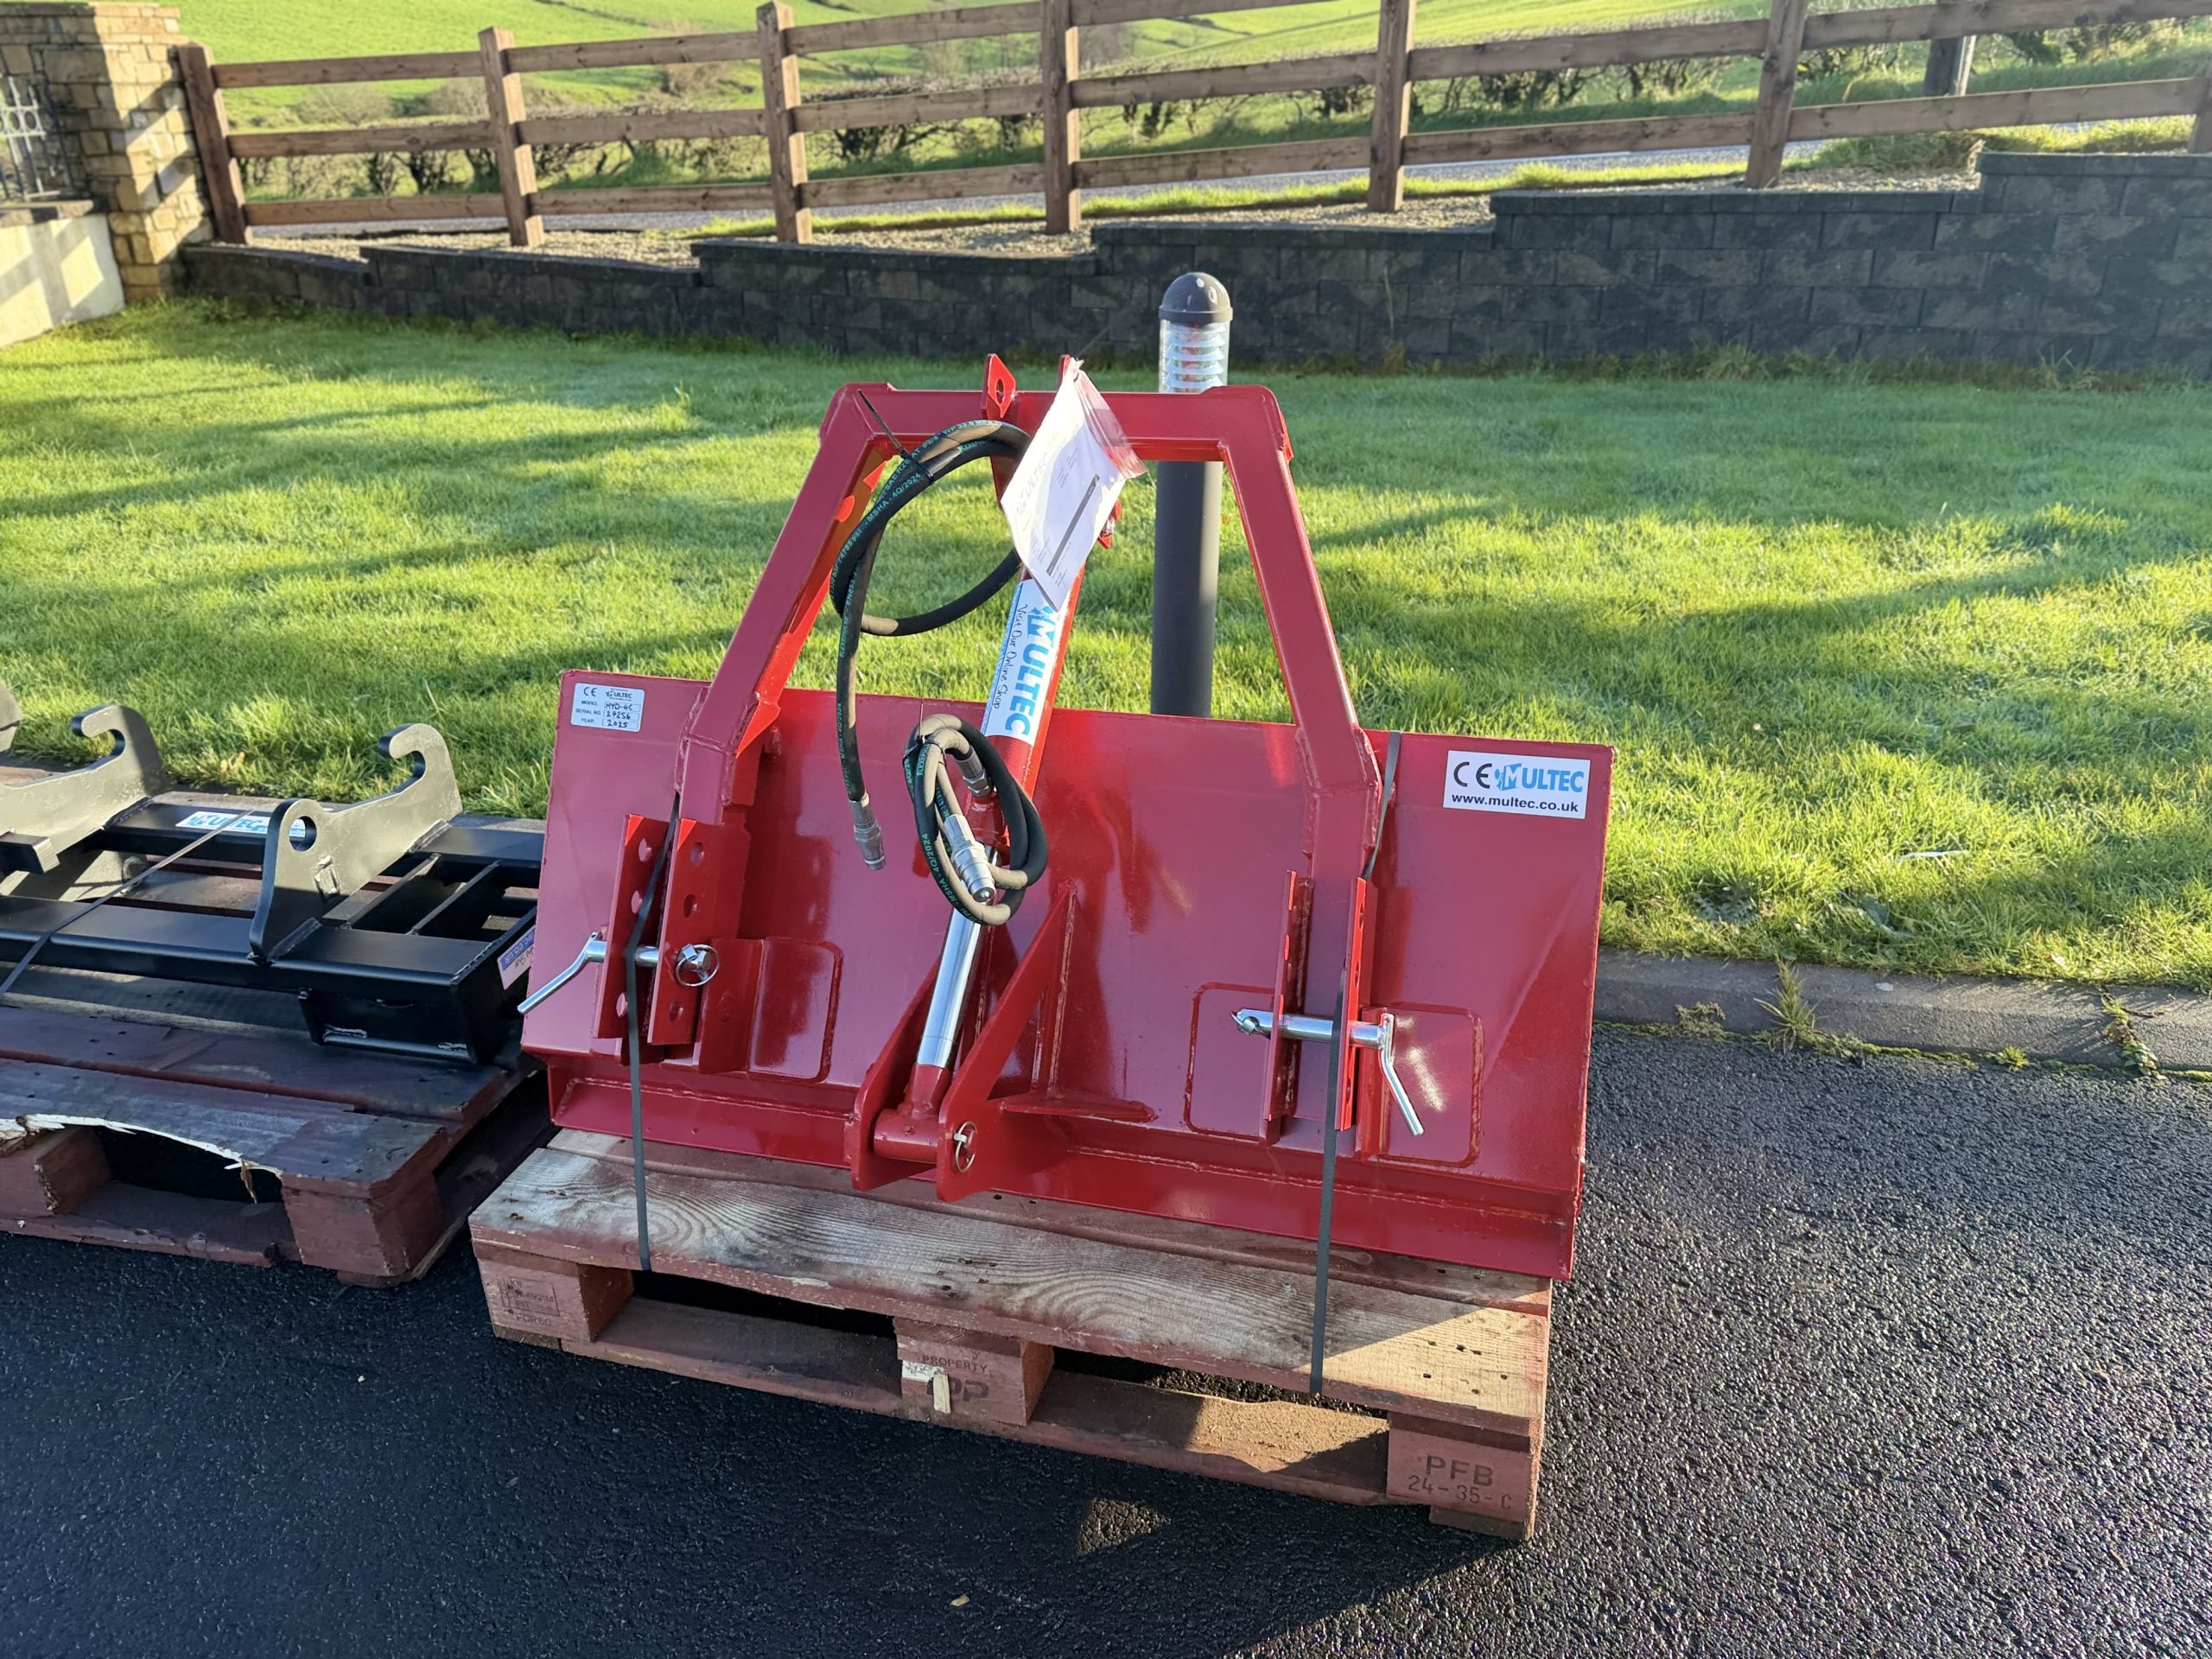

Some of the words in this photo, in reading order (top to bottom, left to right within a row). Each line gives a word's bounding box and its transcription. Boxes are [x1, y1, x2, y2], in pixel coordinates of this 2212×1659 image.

[866, 500, 889, 523] MSHA
[892, 473, 921, 498] 4Q/2024
[1015, 603, 1028, 626] Visit
[1010, 629, 1023, 648] Our
[1001, 650, 1017, 683] Online
[1005, 609, 1057, 735] MULTEC
[993, 683, 1008, 709] Shop
[607, 719, 629, 728] 2025
[1453, 760, 1492, 790] CE
[1495, 762, 1585, 793] MULTEC
[1452, 793, 1579, 813] www.multec.co.uk
[922, 833, 939, 873] 4Q/2024
[939, 878, 957, 902] MSHA
[922, 1355, 988, 1373] PROPERTY
[1426, 1454, 1493, 1487] PFB
